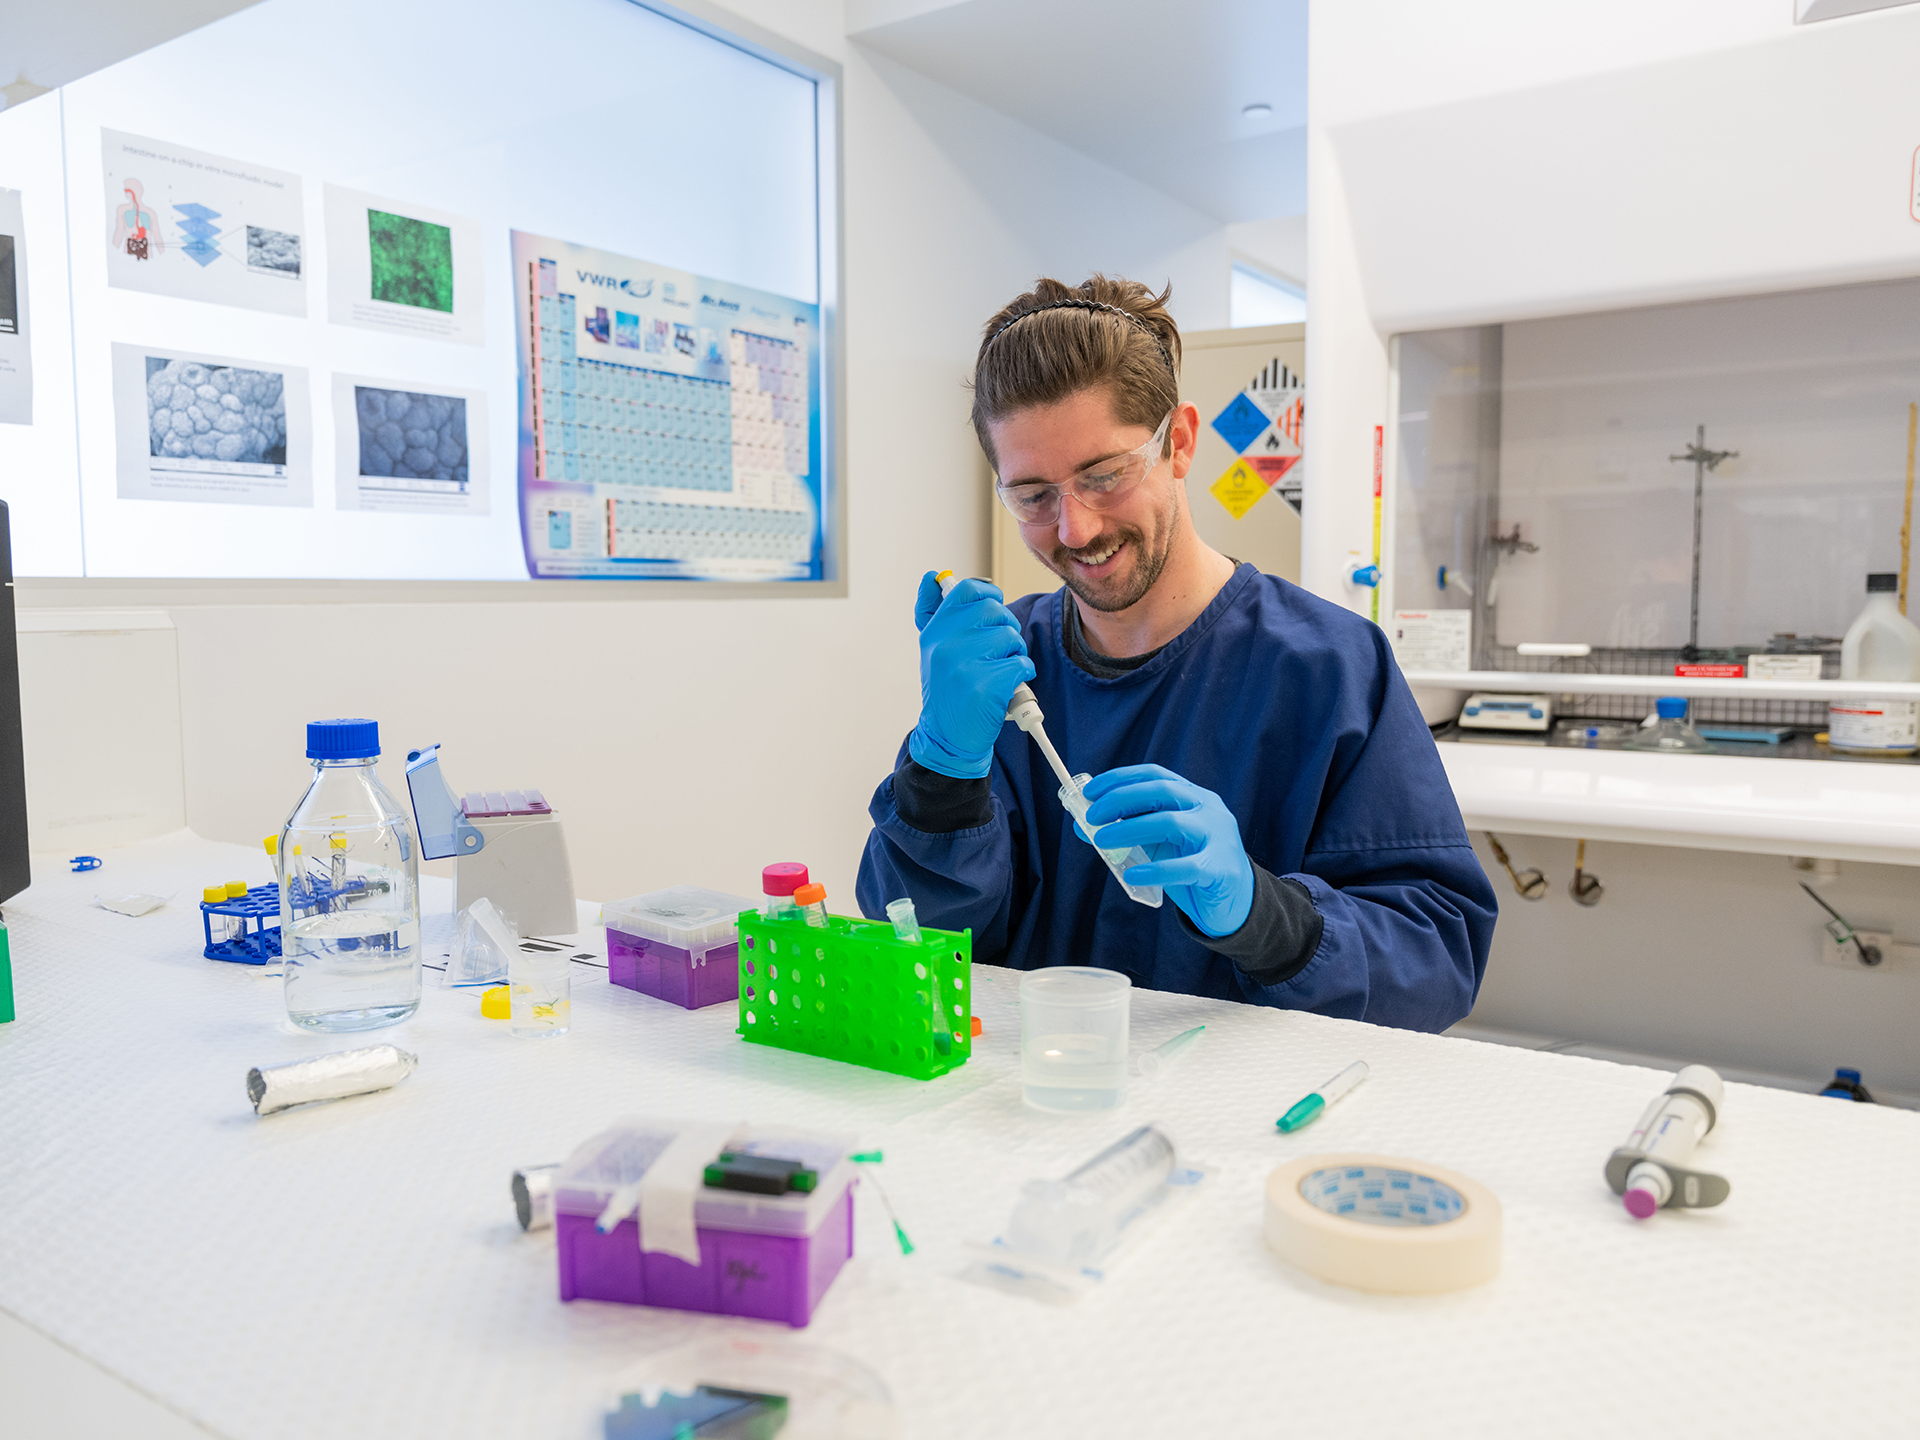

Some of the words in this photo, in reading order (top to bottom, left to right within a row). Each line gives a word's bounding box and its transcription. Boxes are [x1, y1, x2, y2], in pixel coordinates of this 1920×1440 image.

[577, 270, 617, 290] VWR
[367, 888, 382, 897] 700
[370, 945, 384, 953] 400
